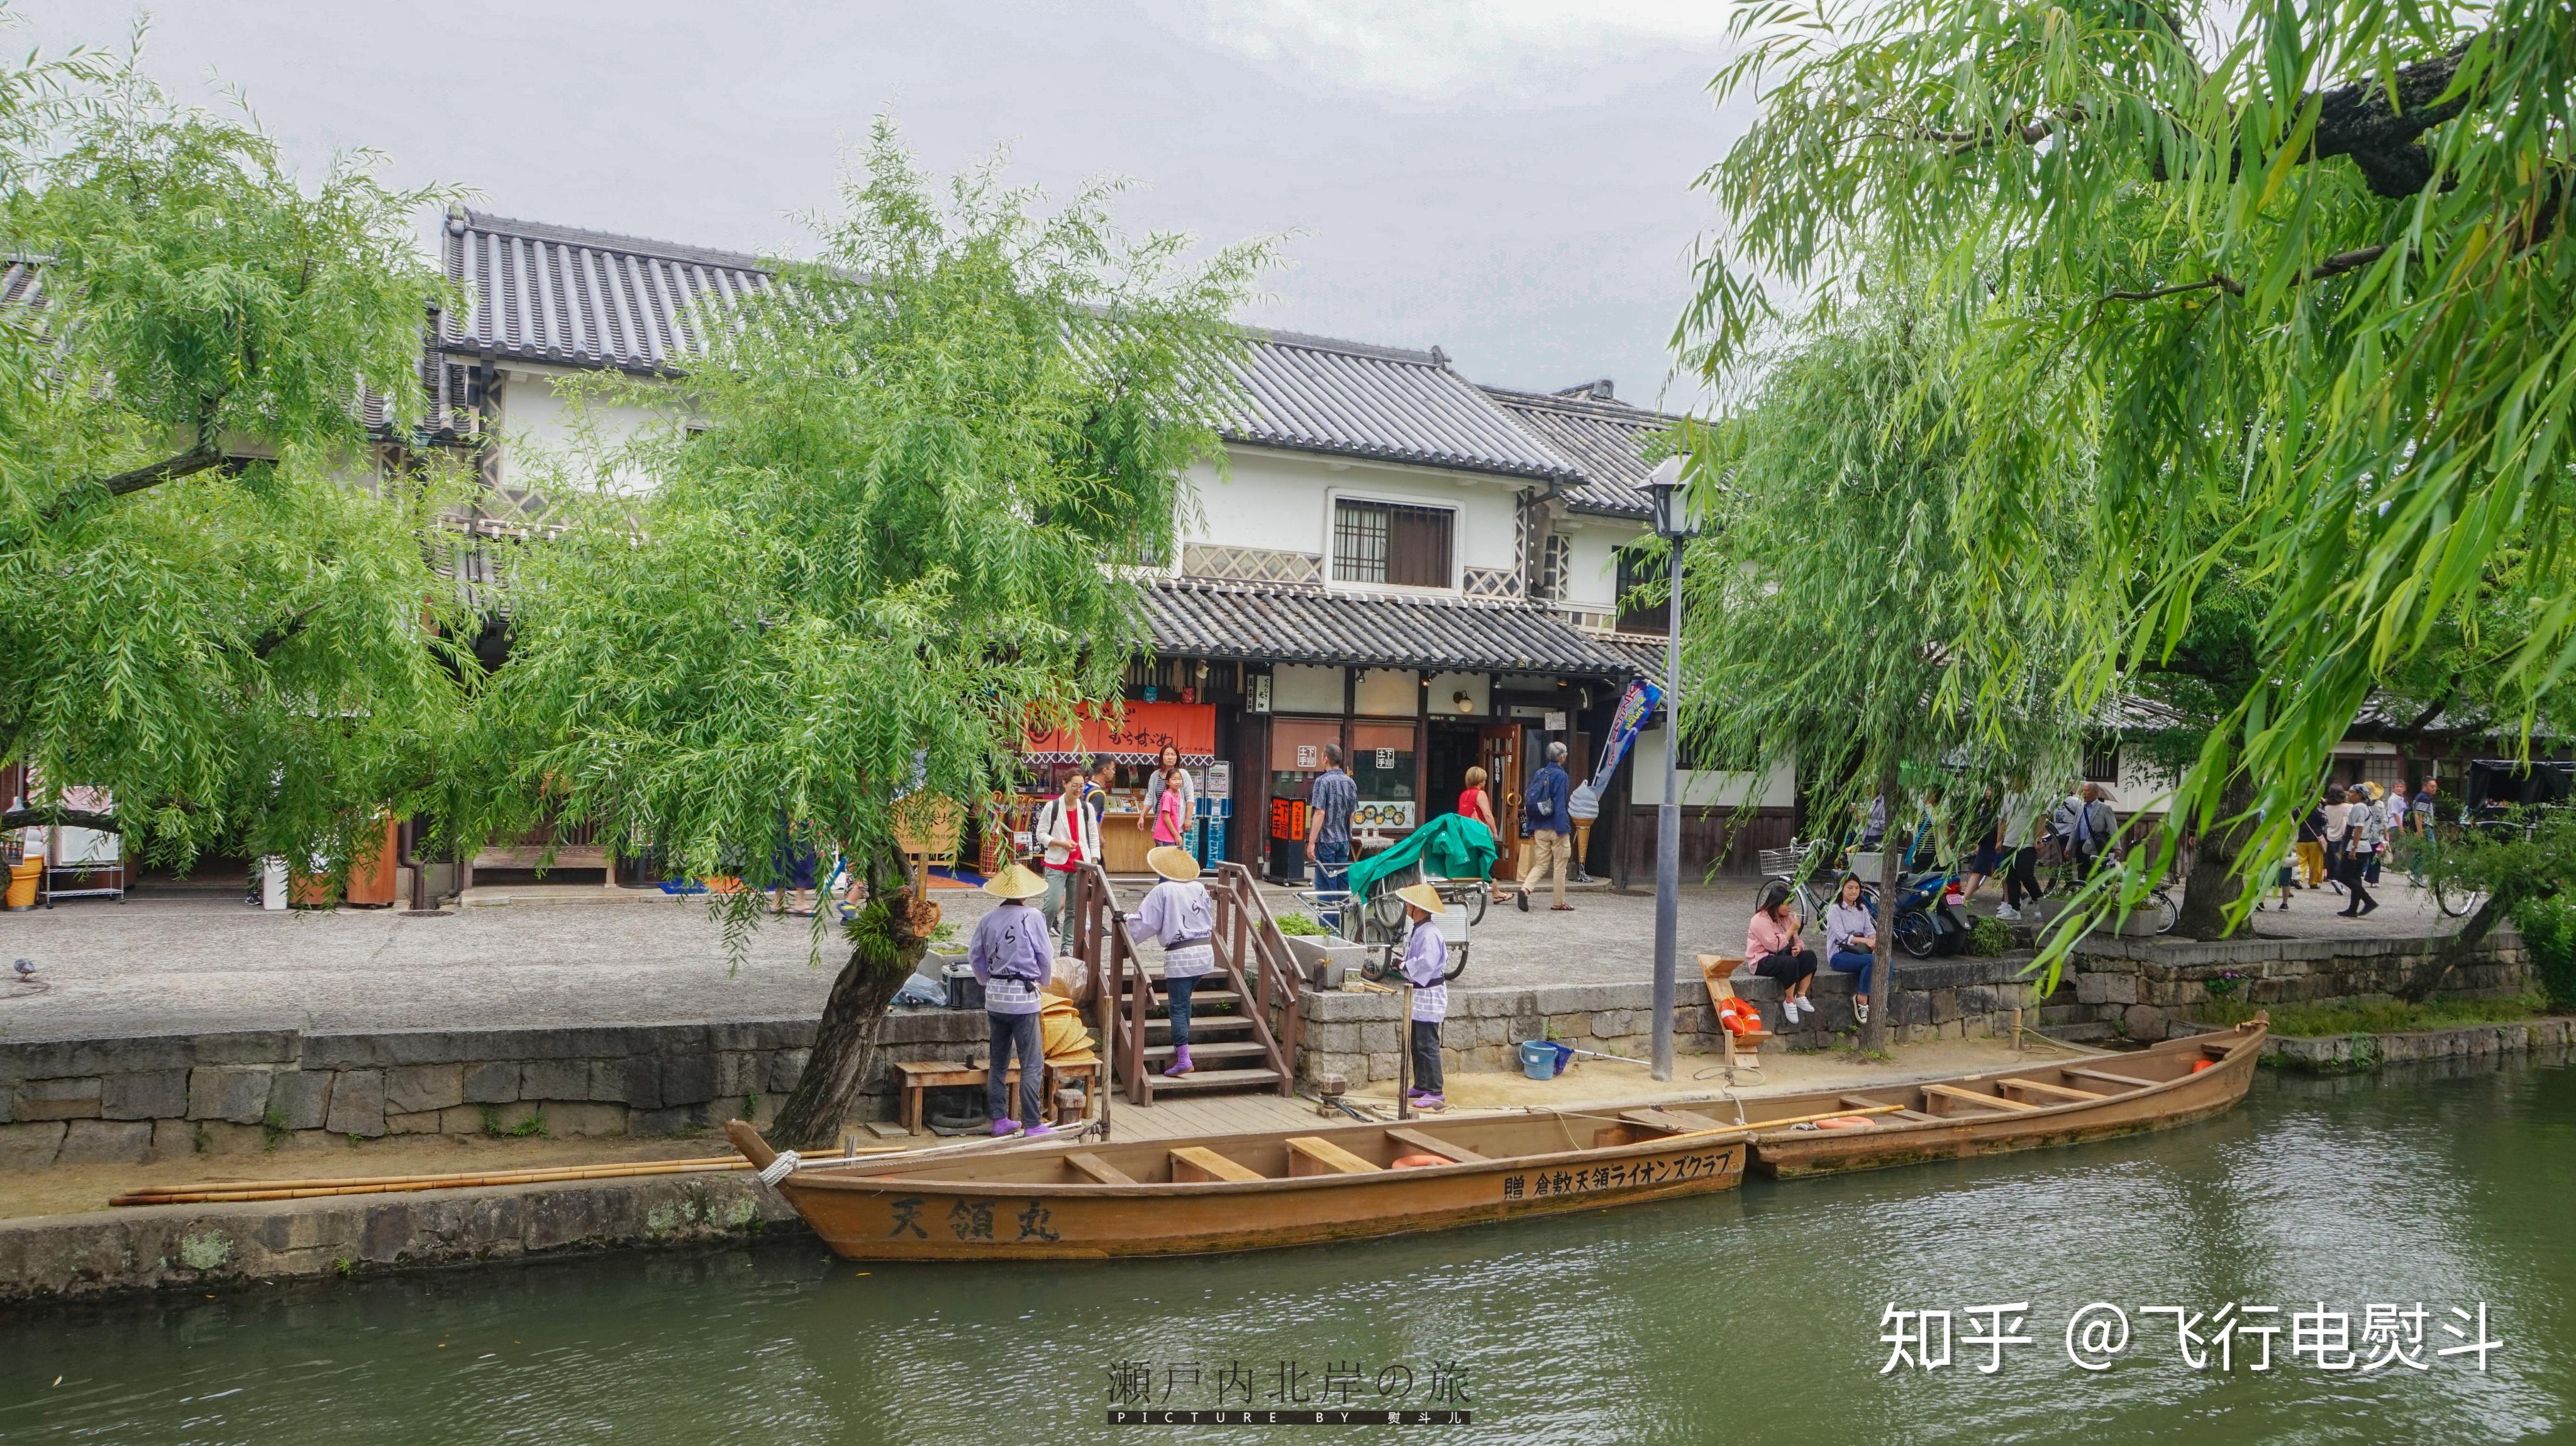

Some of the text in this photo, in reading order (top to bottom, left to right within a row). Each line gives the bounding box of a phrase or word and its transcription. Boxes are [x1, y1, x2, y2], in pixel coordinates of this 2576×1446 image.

[1504, 1150, 1734, 1199] 贈 倉敷天領ライオンズクラブ
[888, 1196, 1061, 1242] 天領丸
